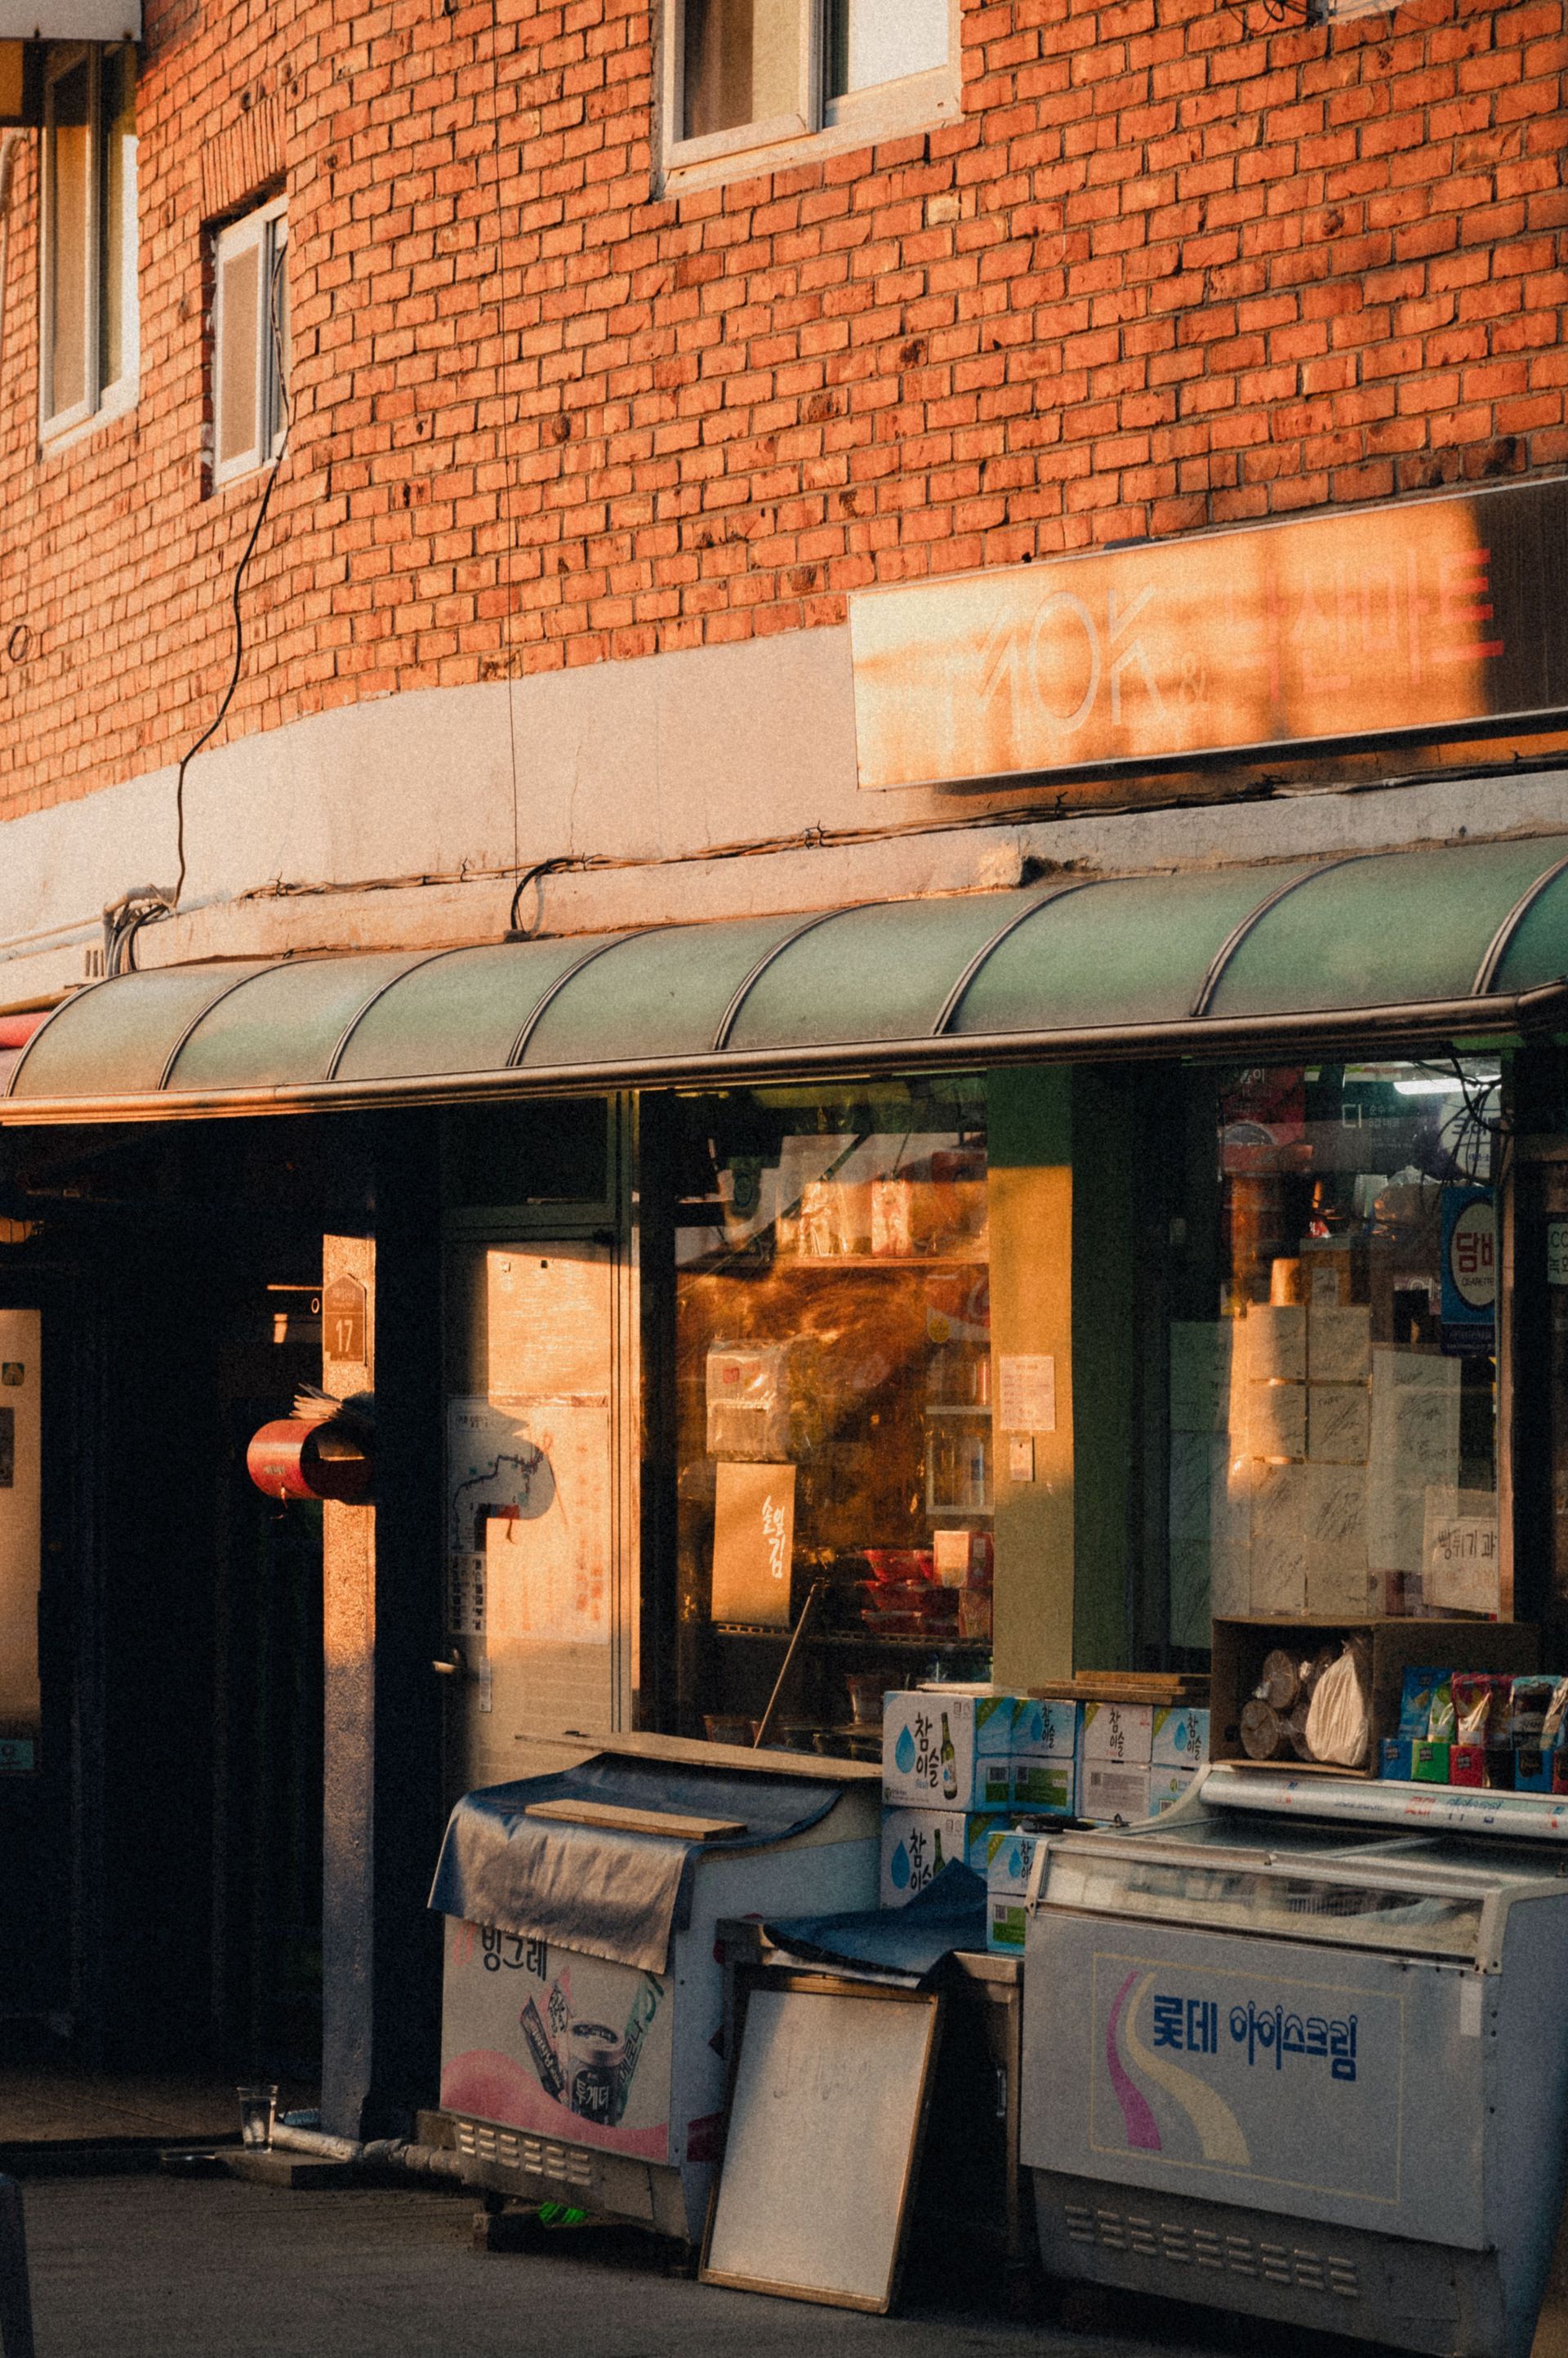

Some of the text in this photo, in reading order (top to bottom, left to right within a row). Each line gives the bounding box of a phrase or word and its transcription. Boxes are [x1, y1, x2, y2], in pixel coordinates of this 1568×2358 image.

[335, 1319, 354, 1353] 17
[914, 1711, 940, 1789] 참이슬
[1108, 1706, 1125, 1758] 참이슬
[1186, 1712, 1202, 1762] 참이슬
[481, 1927, 548, 1981] 빙그레
[1152, 1994, 1359, 2082] 롯데 아이스크림
[576, 2078, 610, 2111] 투게더
